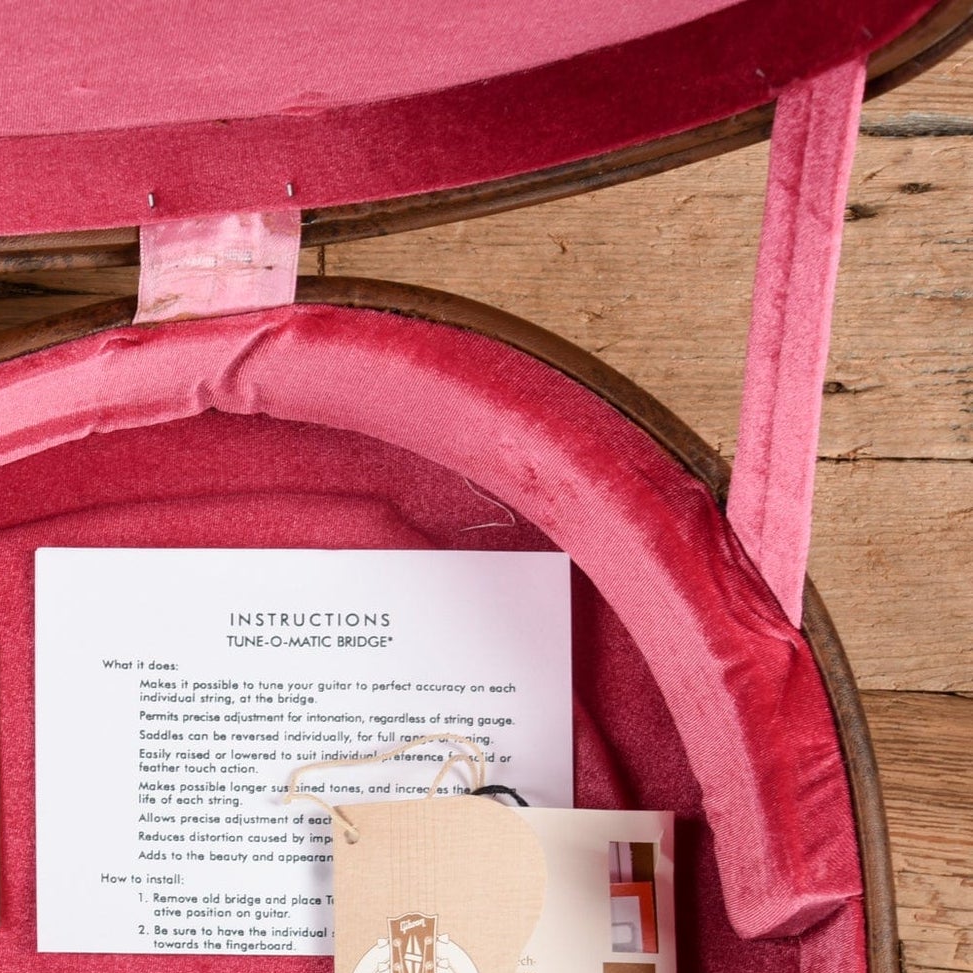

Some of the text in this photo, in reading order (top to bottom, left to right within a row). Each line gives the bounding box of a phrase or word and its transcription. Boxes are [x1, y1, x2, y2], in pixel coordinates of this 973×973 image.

[230, 612, 390, 627] INSTRUCTIONS
[226, 634, 332, 648] TUNE-O-MATIC
[101, 659, 178, 671] What it does:
[139, 692, 317, 706] individual string, at the bridge.
[139, 712, 515, 727] Permits precise adjustment for intonation, regardless of string gauge.
[138, 762, 259, 774] feather touch action.
[100, 873, 184, 885] How to install:
